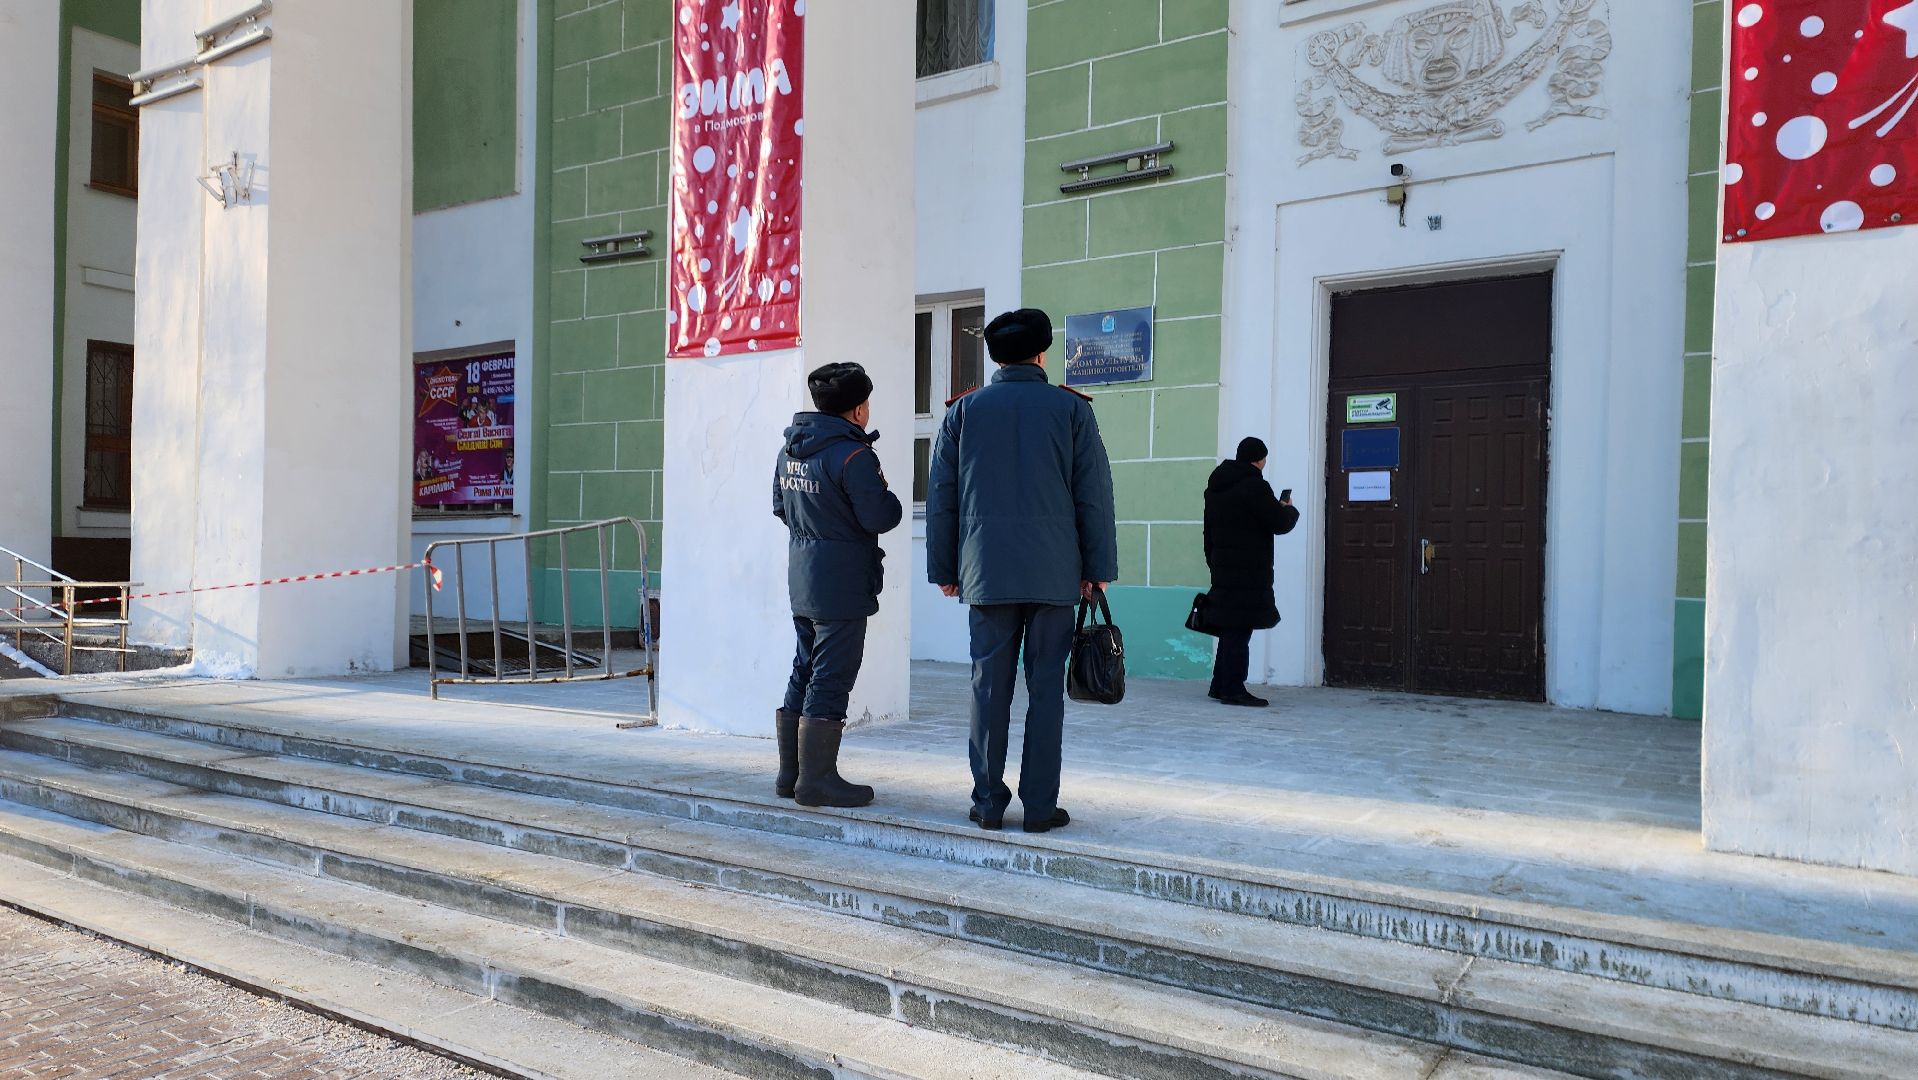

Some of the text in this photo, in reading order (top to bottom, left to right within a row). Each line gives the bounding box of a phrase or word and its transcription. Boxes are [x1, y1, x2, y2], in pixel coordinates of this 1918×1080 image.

[680, 57, 792, 120] ЗИМА
[704, 111, 770, 132] Подмосков
[1073, 355, 1144, 369] ДОМ КУЛЬТУРЫ
[465, 361, 480, 384] 18
[481, 357, 514, 371] ФЕВРАЛ
[429, 386, 455, 400] СССР
[786, 461, 809, 476] МЧС
[493, 485, 514, 497] Жуко
